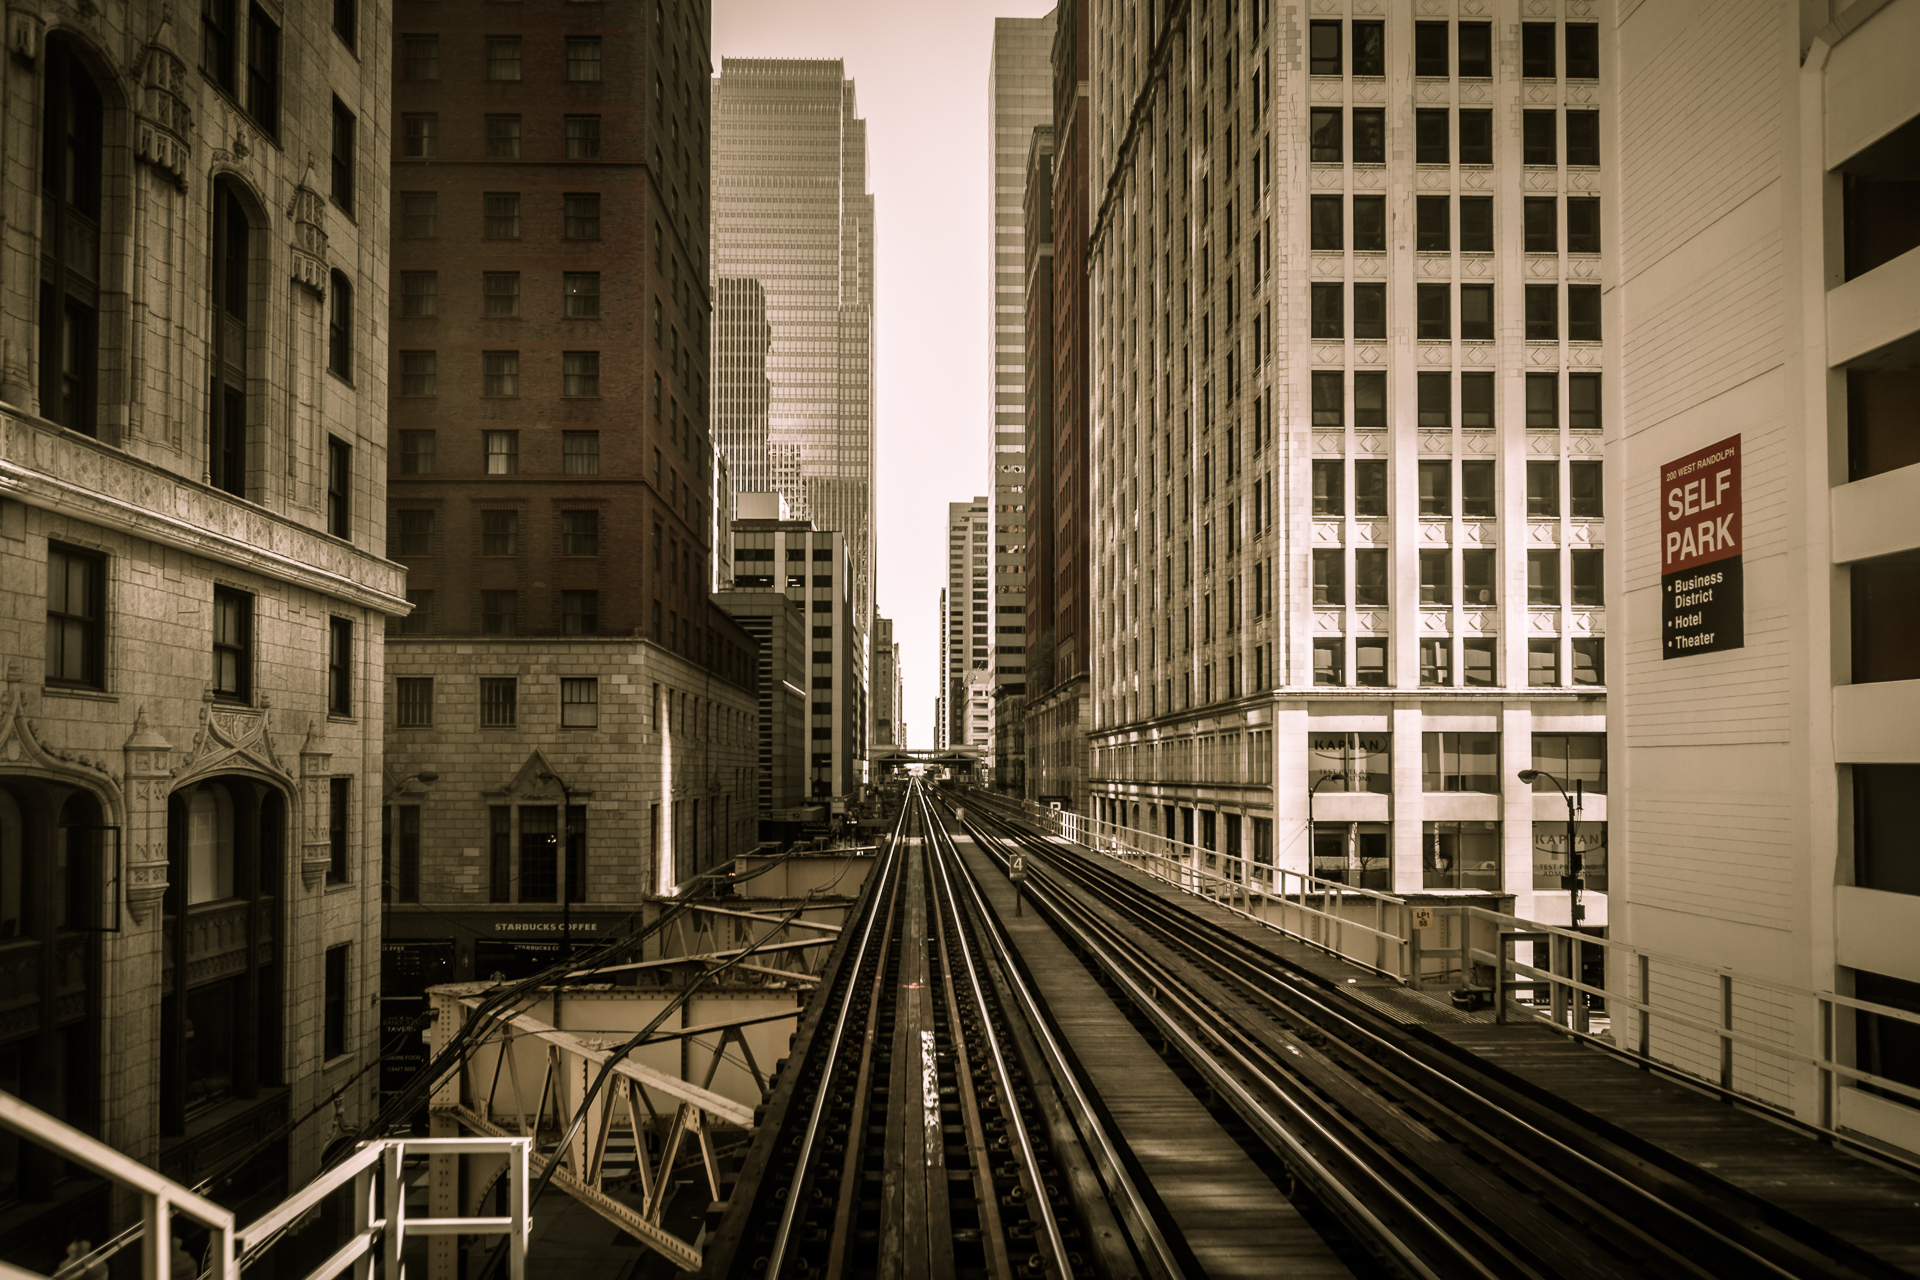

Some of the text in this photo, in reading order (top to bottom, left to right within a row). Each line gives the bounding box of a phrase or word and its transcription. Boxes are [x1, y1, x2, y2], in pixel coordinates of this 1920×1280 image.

[1666, 446, 1735, 482] 200 WEST RANDOLPH
[1668, 468, 1731, 521] SELF
[1666, 512, 1735, 564] PARK
[1675, 572, 1723, 593] Business
[1675, 588, 1713, 609] District
[1675, 611, 1702, 629] Hotel
[1675, 632, 1715, 649] Theater
[1315, 740, 1379, 750] KAPLAN
[1535, 834, 1599, 845] KAPAN
[1013, 857, 1024, 871] 4
[1416, 911, 1430, 919] LP1
[495, 923, 556, 931] STARBUCKS
